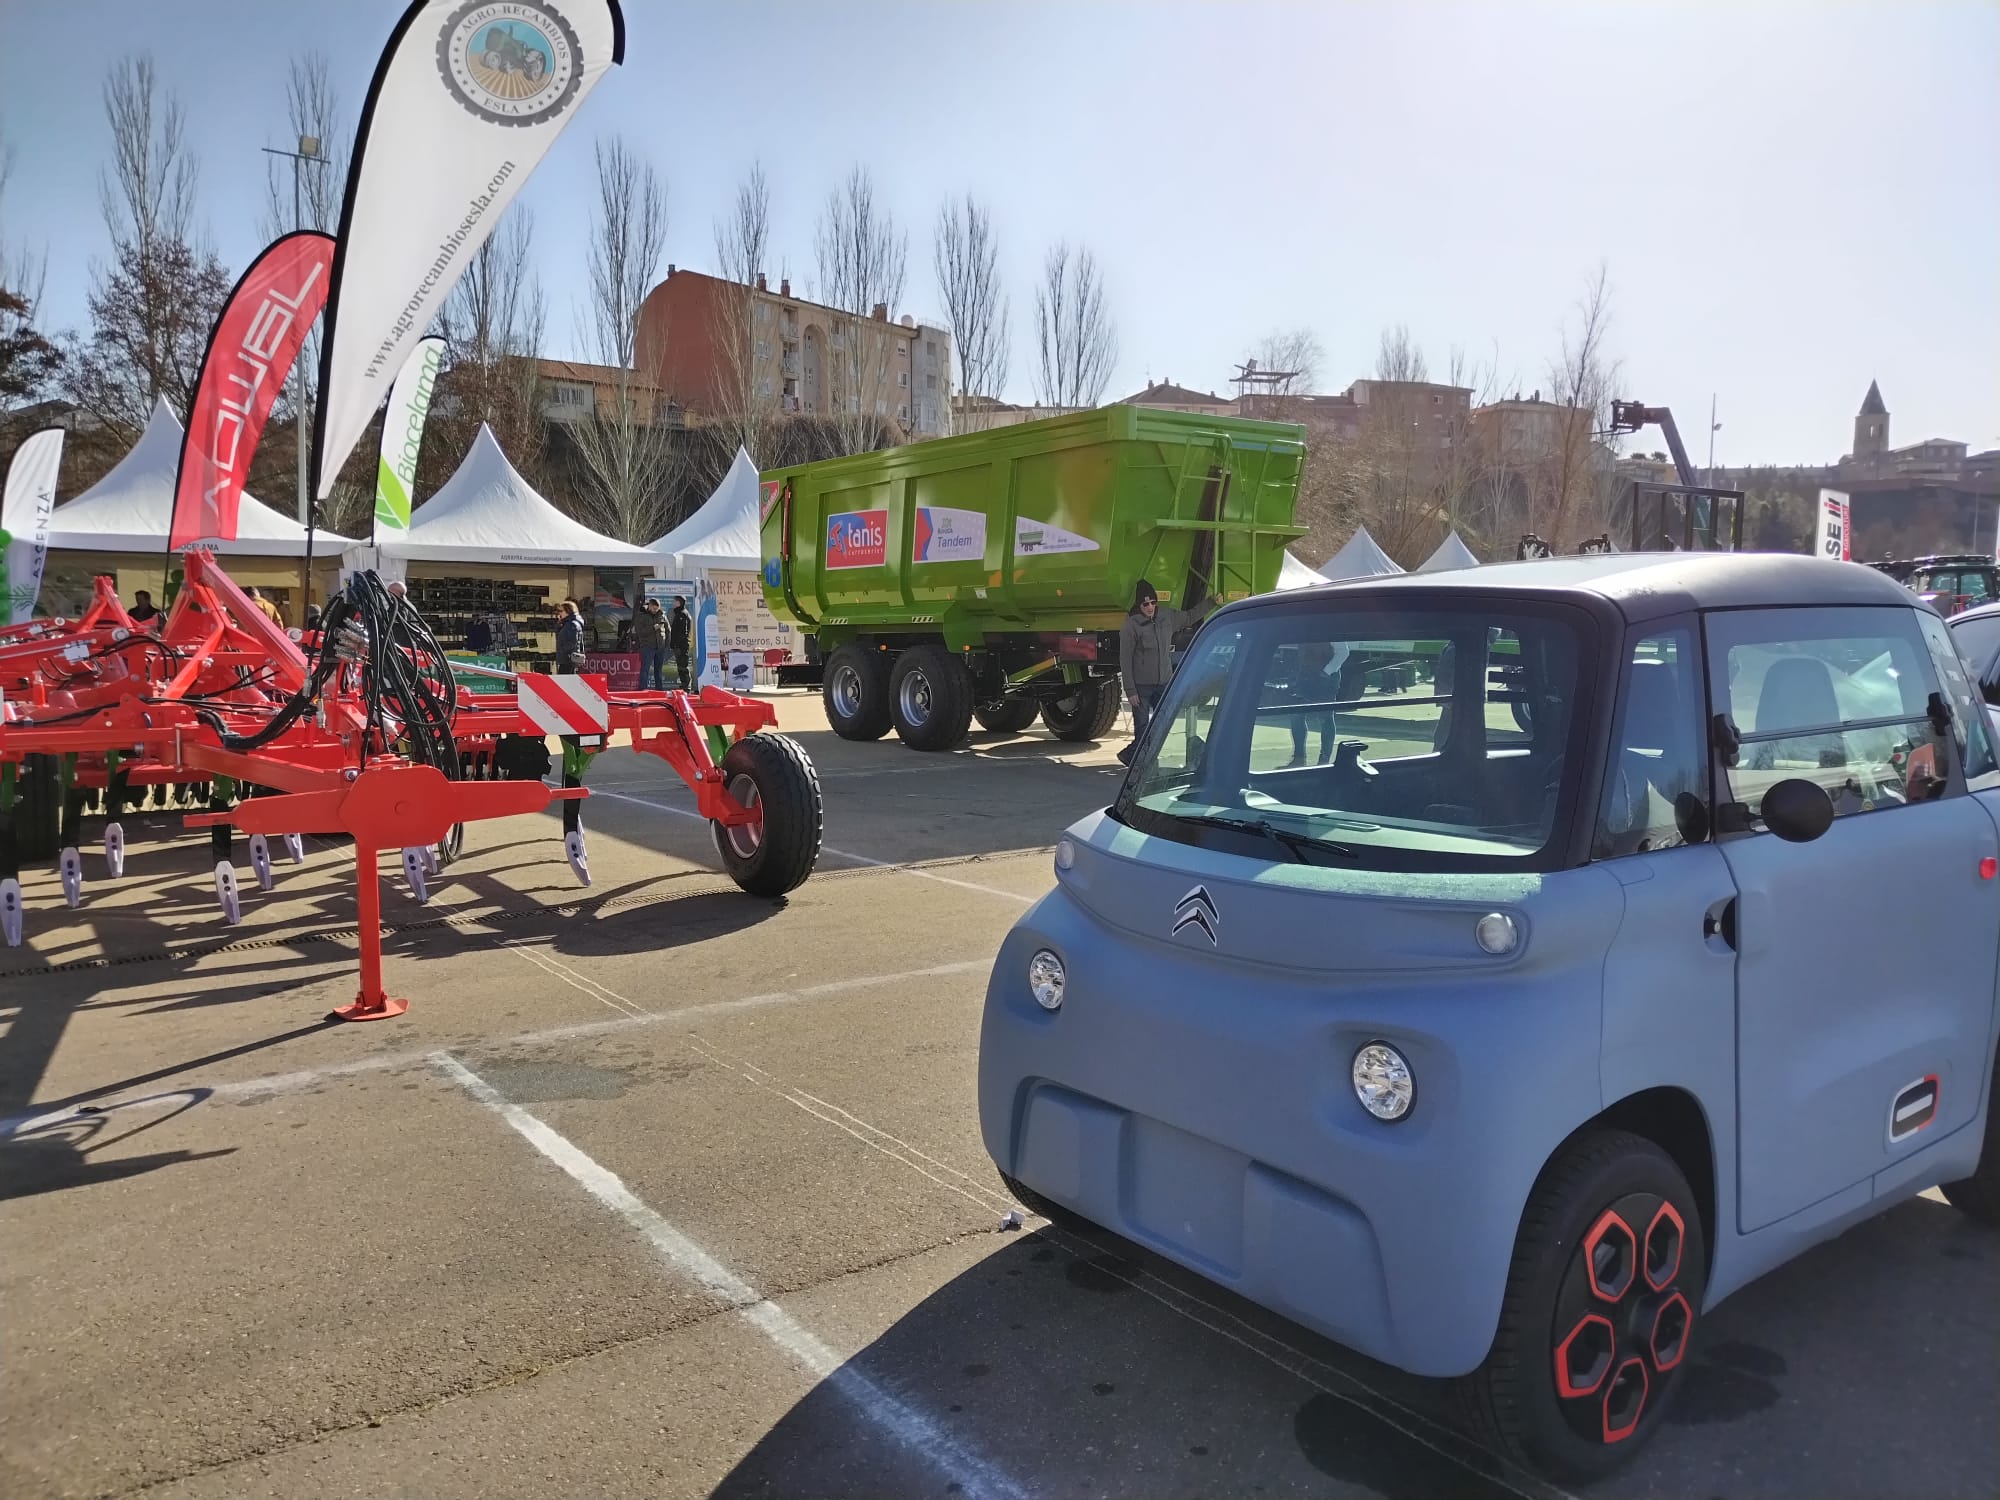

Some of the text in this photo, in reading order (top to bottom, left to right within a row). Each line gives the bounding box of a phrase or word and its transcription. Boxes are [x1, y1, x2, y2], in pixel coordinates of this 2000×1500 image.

[483, 97, 520, 114] ESLA
[364, 160, 516, 380] www.agrorecambiosesla.com
[397, 345, 442, 486] Biocelama
[848, 521, 883, 548] tanis
[937, 536, 972, 548] Tandem
[1825, 522, 1841, 560] SE
[181, 543, 219, 551] OCELAMA
[737, 581, 764, 595] ASES
[722, 636, 733, 646] de
